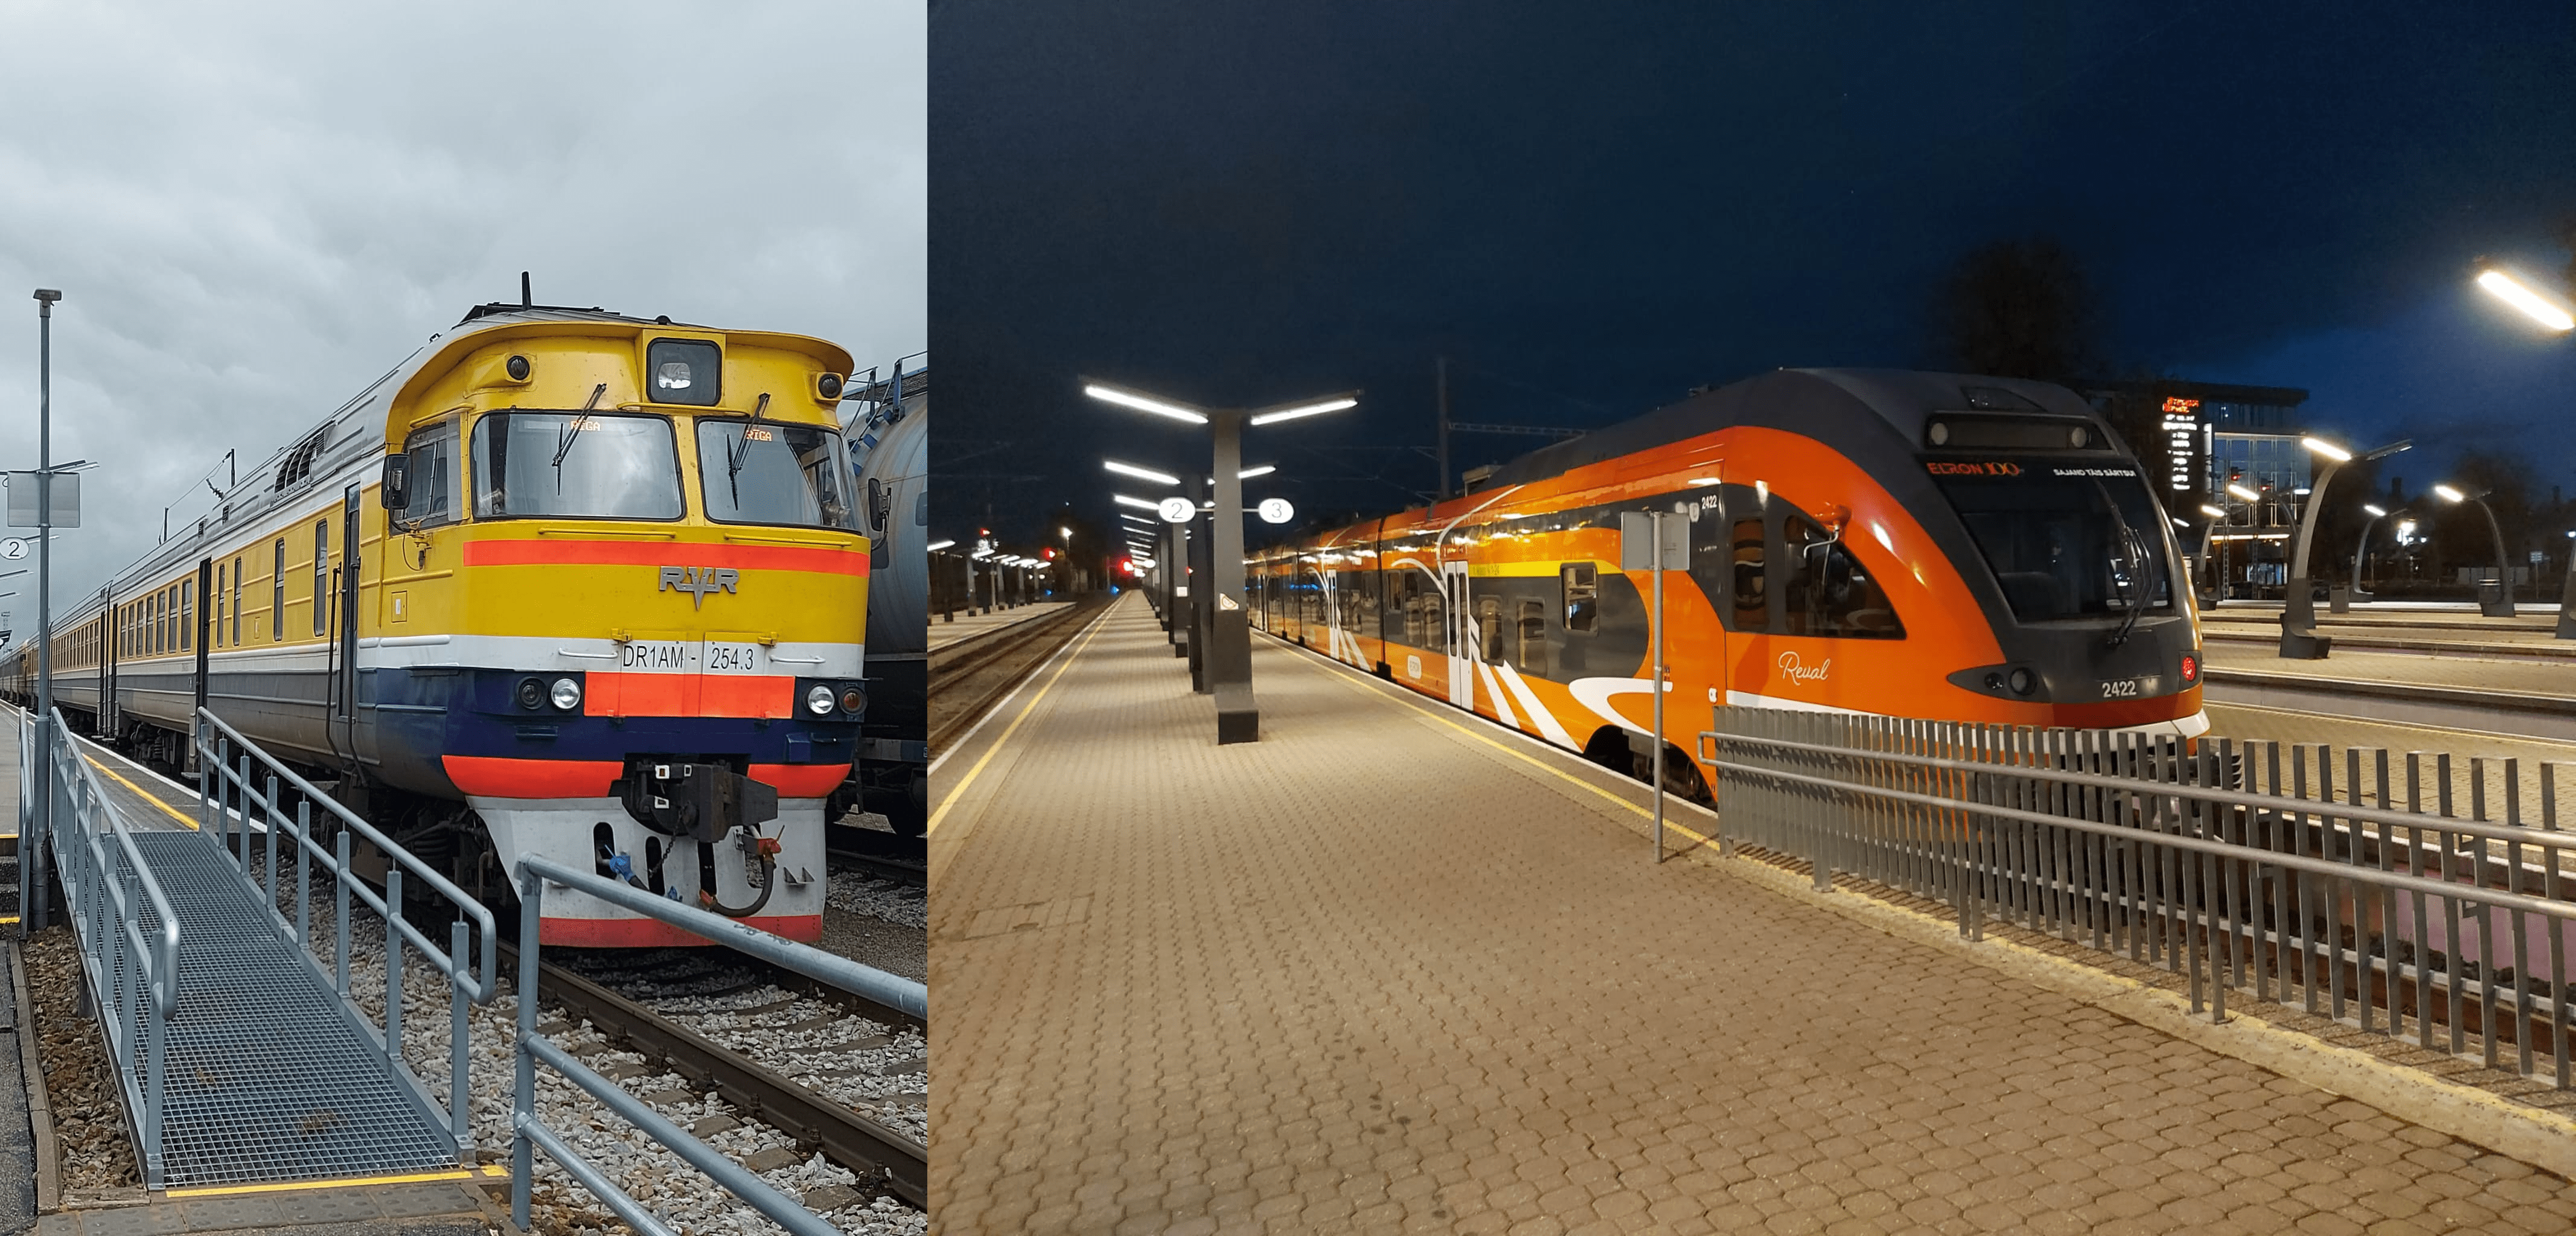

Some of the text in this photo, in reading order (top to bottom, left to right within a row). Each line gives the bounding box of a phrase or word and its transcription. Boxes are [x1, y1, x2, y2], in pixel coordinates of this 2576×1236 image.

[1926, 462, 1984, 475] ELRON
[1701, 494, 1717, 509] 2422
[1171, 502, 1183, 518] 2
[1271, 502, 1282, 518] 3
[8, 541, 20, 556] 2
[659, 565, 740, 612] RVR
[622, 645, 684, 669] DR1AM
[711, 647, 754, 671] 254.3
[1778, 651, 1831, 686] Reval
[2102, 680, 2137, 698] 2422
